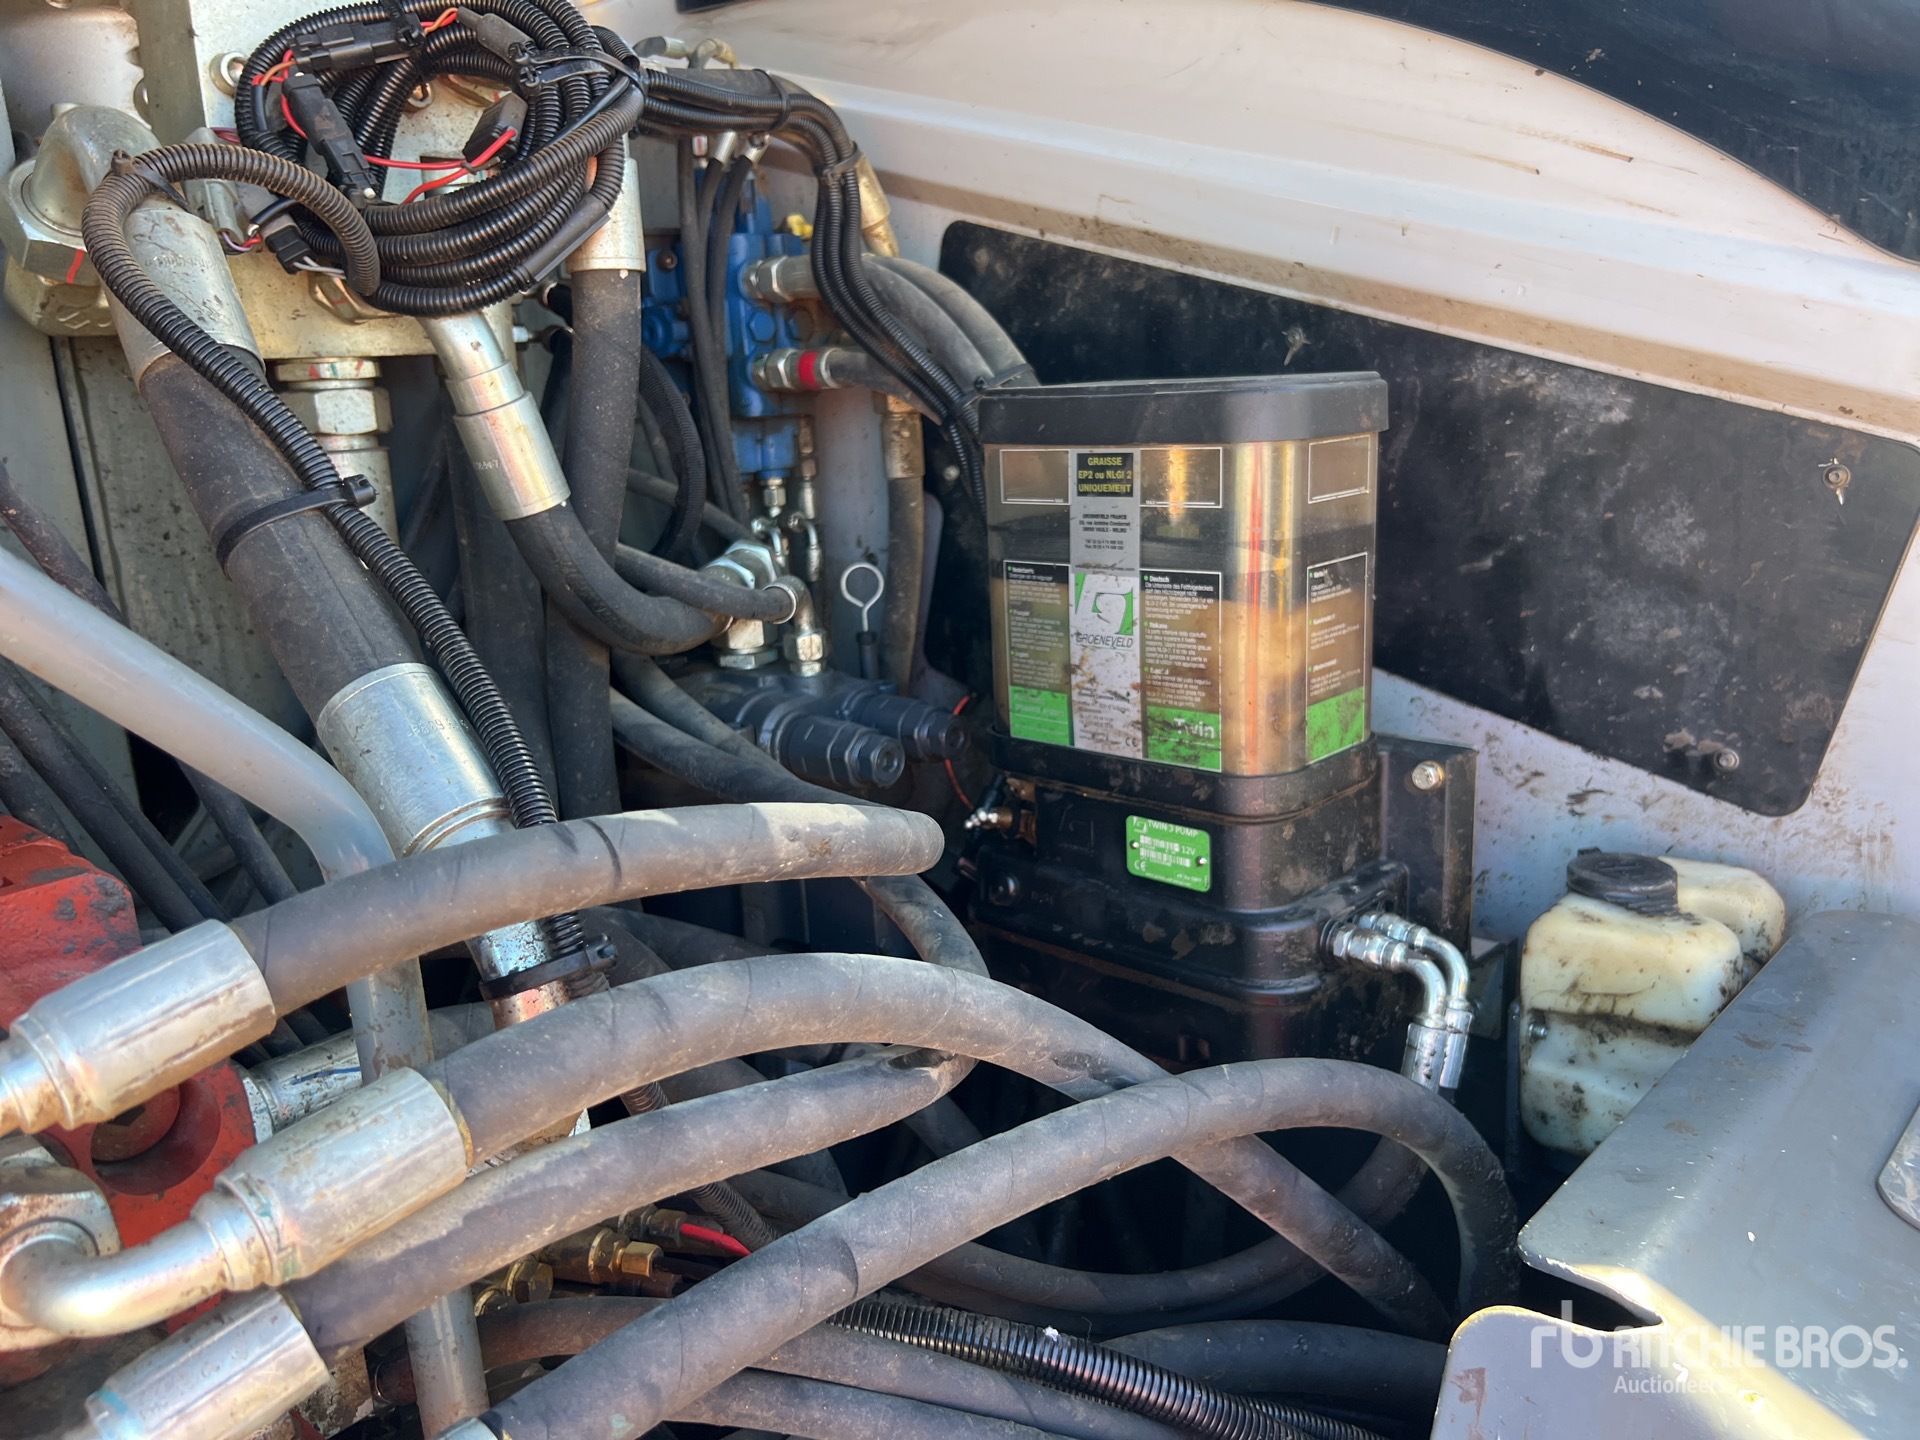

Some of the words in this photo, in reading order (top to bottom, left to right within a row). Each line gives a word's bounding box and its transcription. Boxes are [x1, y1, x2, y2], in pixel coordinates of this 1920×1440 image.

[1087, 457, 1123, 466] GRAISSE
[1078, 470, 1093, 479] EP2
[1126, 471, 1132, 479] 2
[1078, 484, 1131, 493] UNIQUEMENT
[1075, 633, 1134, 649] GROENEVELD
[1173, 717, 1215, 739] Twin
[1147, 819, 1168, 831] TWIN
[1168, 824, 1174, 832] 3
[1175, 825, 1198, 837] PUMP
[1181, 845, 1196, 855] 12V
